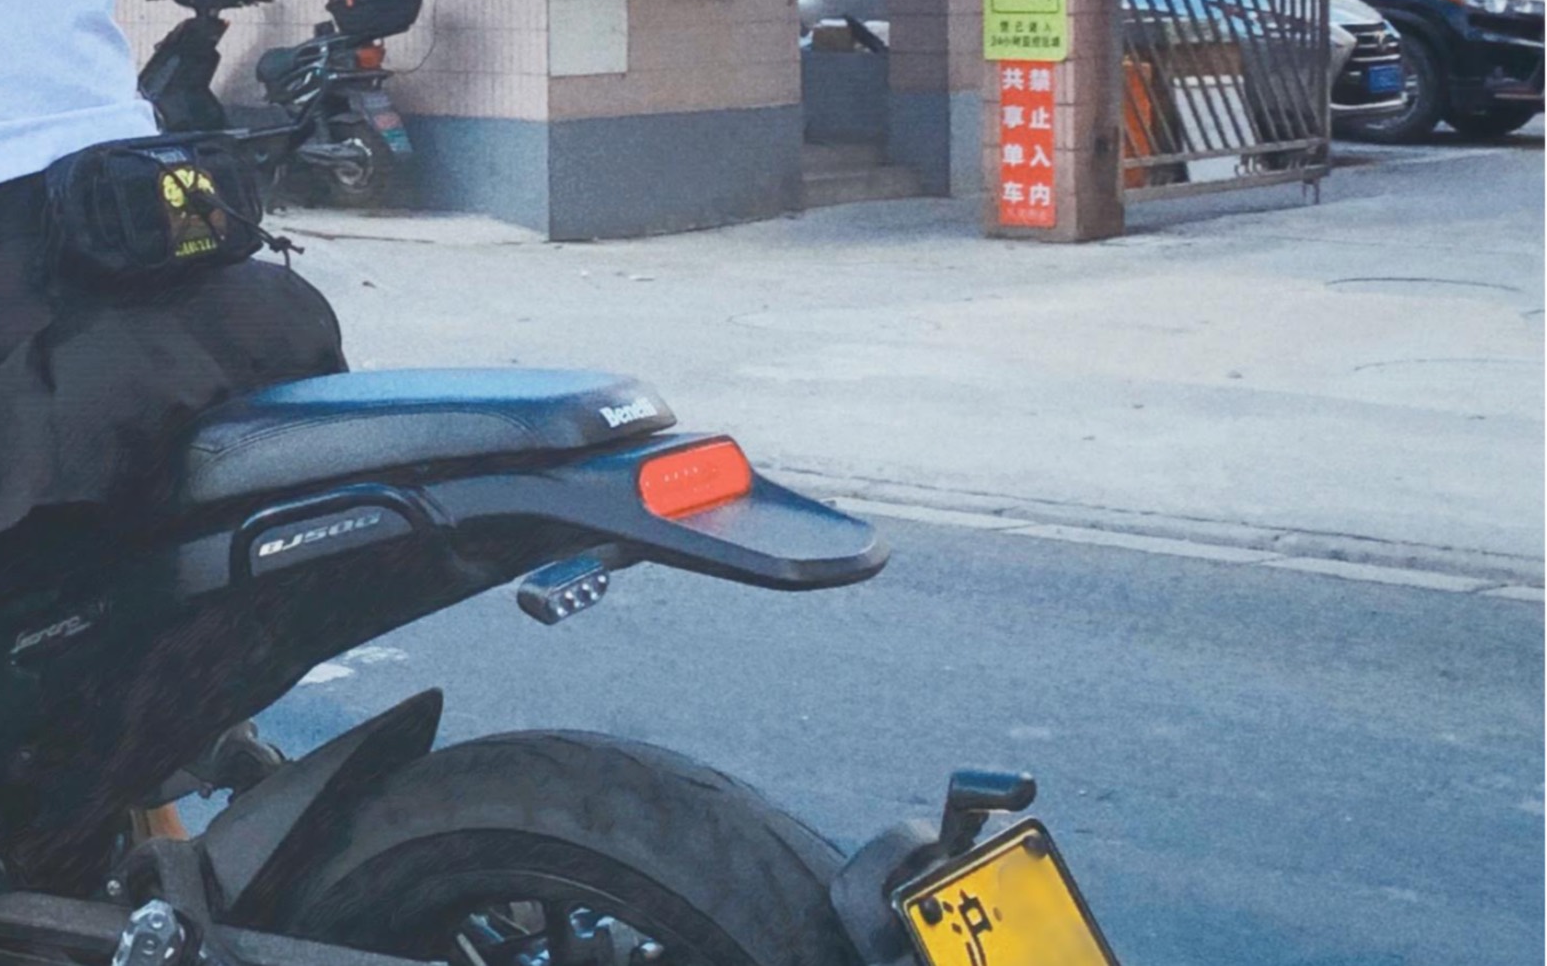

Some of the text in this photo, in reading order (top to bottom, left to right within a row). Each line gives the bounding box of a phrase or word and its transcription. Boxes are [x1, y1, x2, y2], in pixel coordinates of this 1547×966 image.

[1002, 68, 1025, 204] 共享单车
[1029, 68, 1052, 206] 禁止入内
